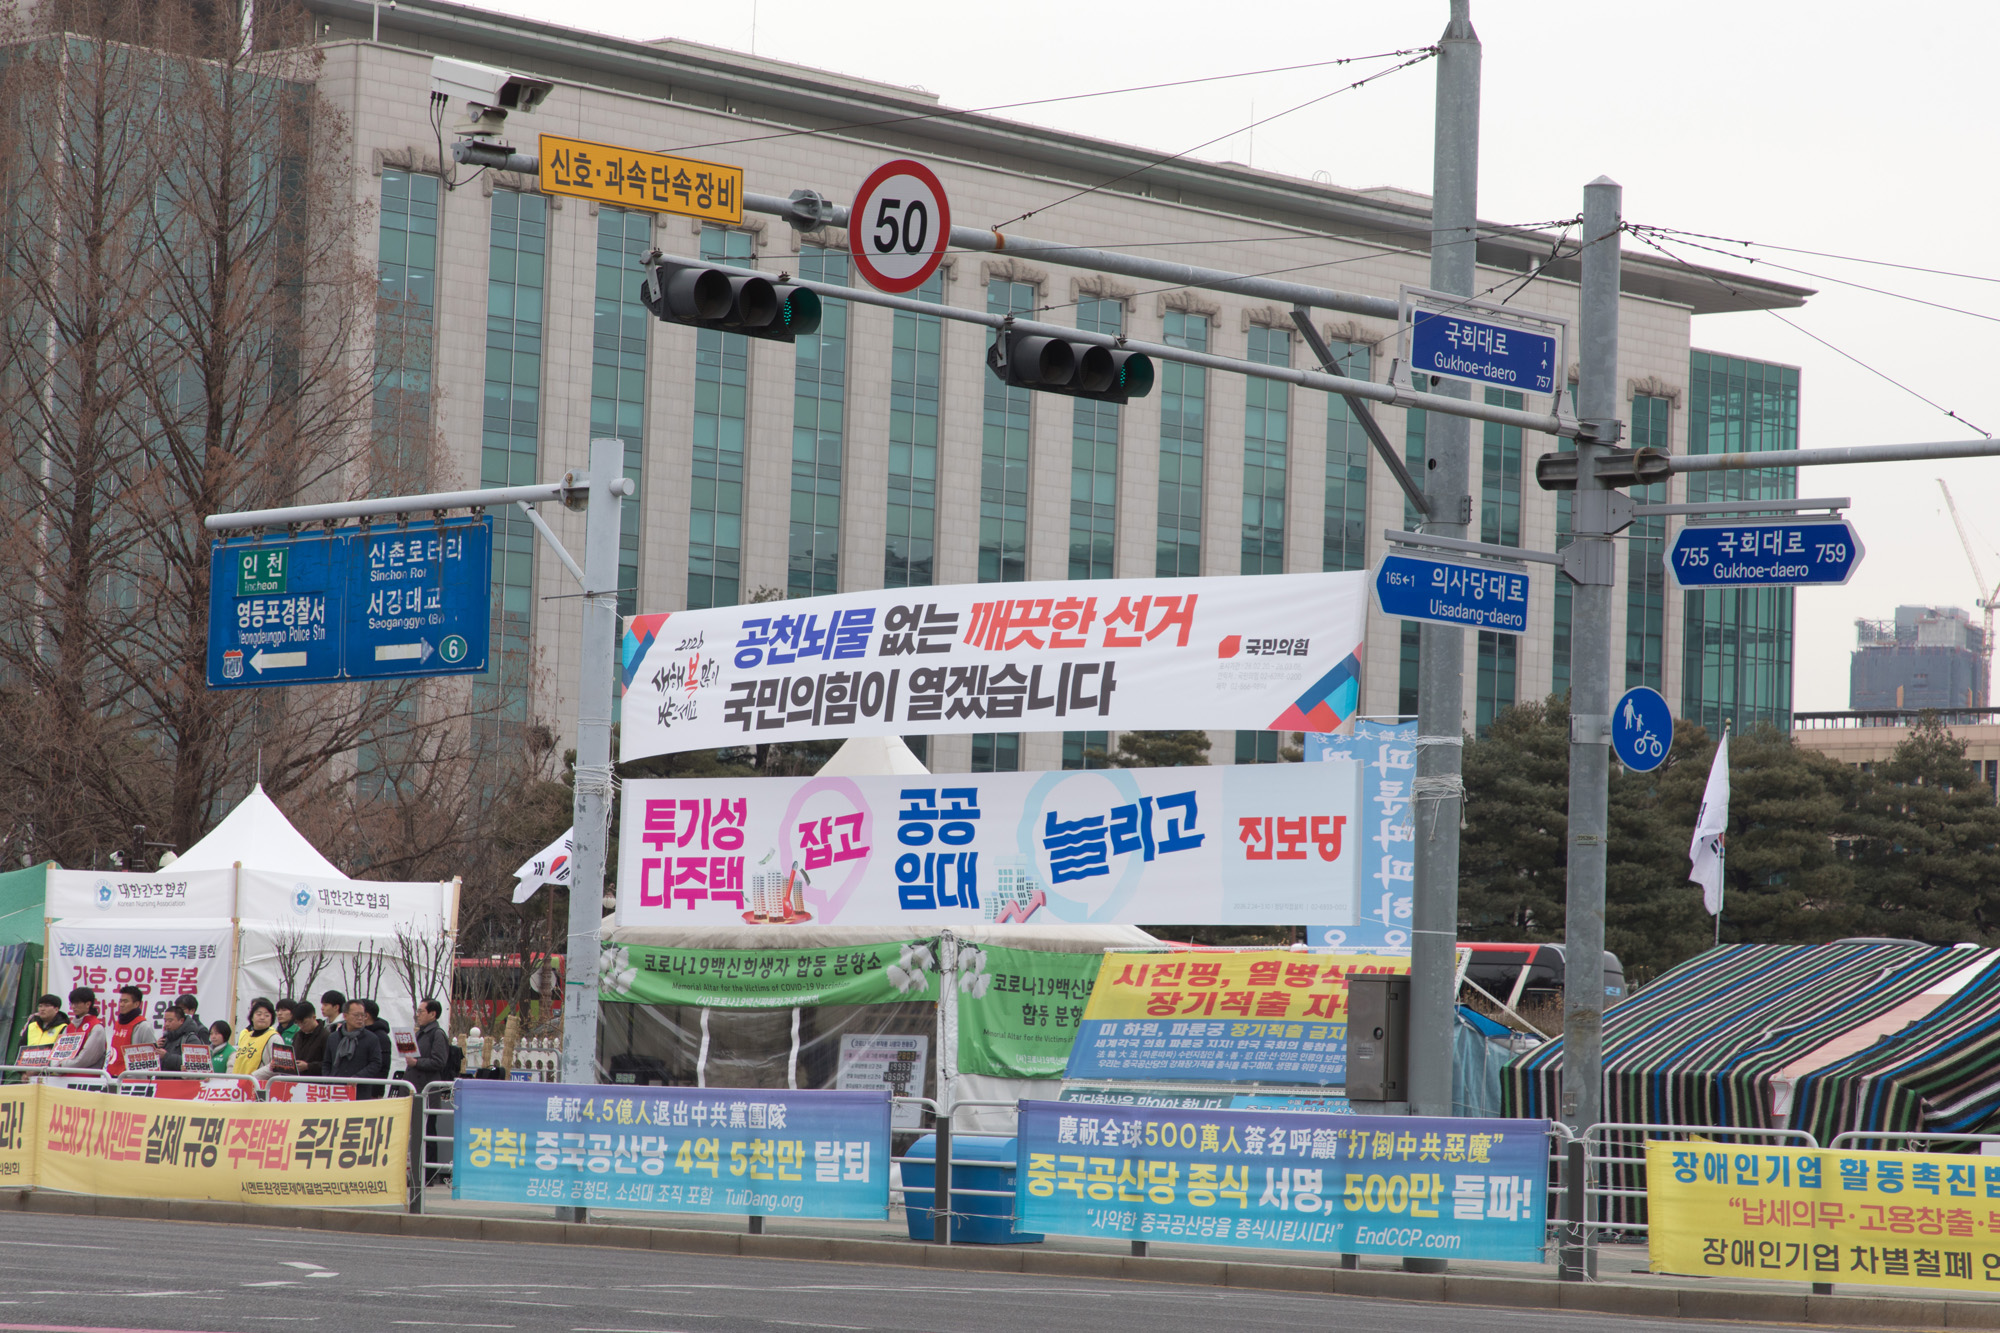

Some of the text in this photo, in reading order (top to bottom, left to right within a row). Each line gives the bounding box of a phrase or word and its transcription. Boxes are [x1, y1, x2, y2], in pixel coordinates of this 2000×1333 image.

[550, 148, 735, 214] 신호·과속단속장비
[873, 198, 928, 256] 50
[1445, 321, 1547, 355] 국회대로 1
[1434, 351, 1551, 389] Gukhoe-daero 757
[369, 535, 462, 568] 신촌로터리
[1680, 530, 1846, 567] 755 국회대로 759
[370, 570, 408, 582] Sinchon
[1386, 571, 1401, 585] 165
[1431, 566, 1525, 603] 의사당대로
[1713, 562, 1809, 579] Gukhoe-daero
[237, 596, 325, 628] 영등포경찰서
[366, 586, 441, 616] 서강대교
[1430, 599, 1523, 627] Uisadang-daero
[289, 626, 310, 642] Police
[368, 617, 426, 631] Seoganggyo
[733, 594, 1199, 669] 공천뇌물 없는 깨끗한 선거
[448, 639, 458, 658] 6
[1245, 638, 1310, 656] 국민의힘
[684, 652, 700, 699] 복
[723, 661, 1117, 732] 국민의힘이 열겠습니다
[642, 787, 1347, 884] 투기성 잡고 공공 늘리고 진보당
[117, 881, 187, 899] 대한간호협회
[640, 851, 980, 910] 다주택 임대
[318, 888, 390, 910] 대한간호협회
[59, 942, 84, 957] 간호사
[85, 943, 112, 958] 중심의
[113, 943, 131, 959] 협력
[132, 944, 167, 959] 거버넌스
[169, 944, 196, 960] 구축을
[644, 951, 883, 979] 코로나19백신희생자 합동 분향소
[702, 983, 719, 991] Altar
[721, 983, 731, 991] for
[731, 983, 743, 992] the
[743, 983, 771, 992] Victims
[771, 983, 779, 992] of
[780, 982, 815, 992] COVID-19
[1112, 962, 1231, 989] 시진핑,
[1022, 1003, 1050, 1027] 합동
[1146, 990, 1348, 1019] 장기적출 자
[1007, 1032, 1022, 1041] Altar
[1024, 1032, 1034, 1041] for
[1034, 1033, 1043, 1042] the
[1044, 1033, 1067, 1043] Victims
[1094, 1039, 1140, 1048] 세계각국
[1142, 1039, 1166, 1048] 의회
[1168, 1039, 1204, 1048] 파룬궁
[1206, 1039, 1235, 1049] 지지!
[1237, 1040, 1261, 1050] 한국
[1263, 1040, 1299, 1050] 국회의
[1302, 1041, 1338, 1052] 동참을
[1099, 1022, 1118, 1036] 미
[1123, 1022, 1164, 1037] 하원,
[1169, 1022, 1225, 1037] 파룬궁
[1230, 1023, 1304, 1039] 장기적출
[1098, 1059, 1121, 1068] 우리는
[1301, 1062, 1317, 1072] 위한
[546, 1095, 788, 1130] 慶祝4.5億人退出中共黨團隊
[47, 1103, 96, 1158] 쓰레기
[93, 1110, 147, 1162] 시멘트
[145, 1115, 186, 1166] 실체
[183, 1117, 225, 1168] 규명
[294, 1117, 340, 1170] 즉각
[338, 1115, 394, 1169] 통과!
[468, 1127, 870, 1183] 경축! 중국공산당 4억 5천만 탈퇴
[1672, 1151, 1822, 1190] 장애인기업
[526, 1177, 804, 1212] 공산당, 공청단, 소선대 조직 포함 TuiDang.org
[1028, 1152, 1532, 1222] 중국공산당 종식 서명, 500만 돌파!
[1087, 1208, 1461, 1249] “사악한 중국공산당을 종식시킵시다!” EndCCP.com
[1702, 1236, 1973, 1280] 장애인기업 차별철폐
